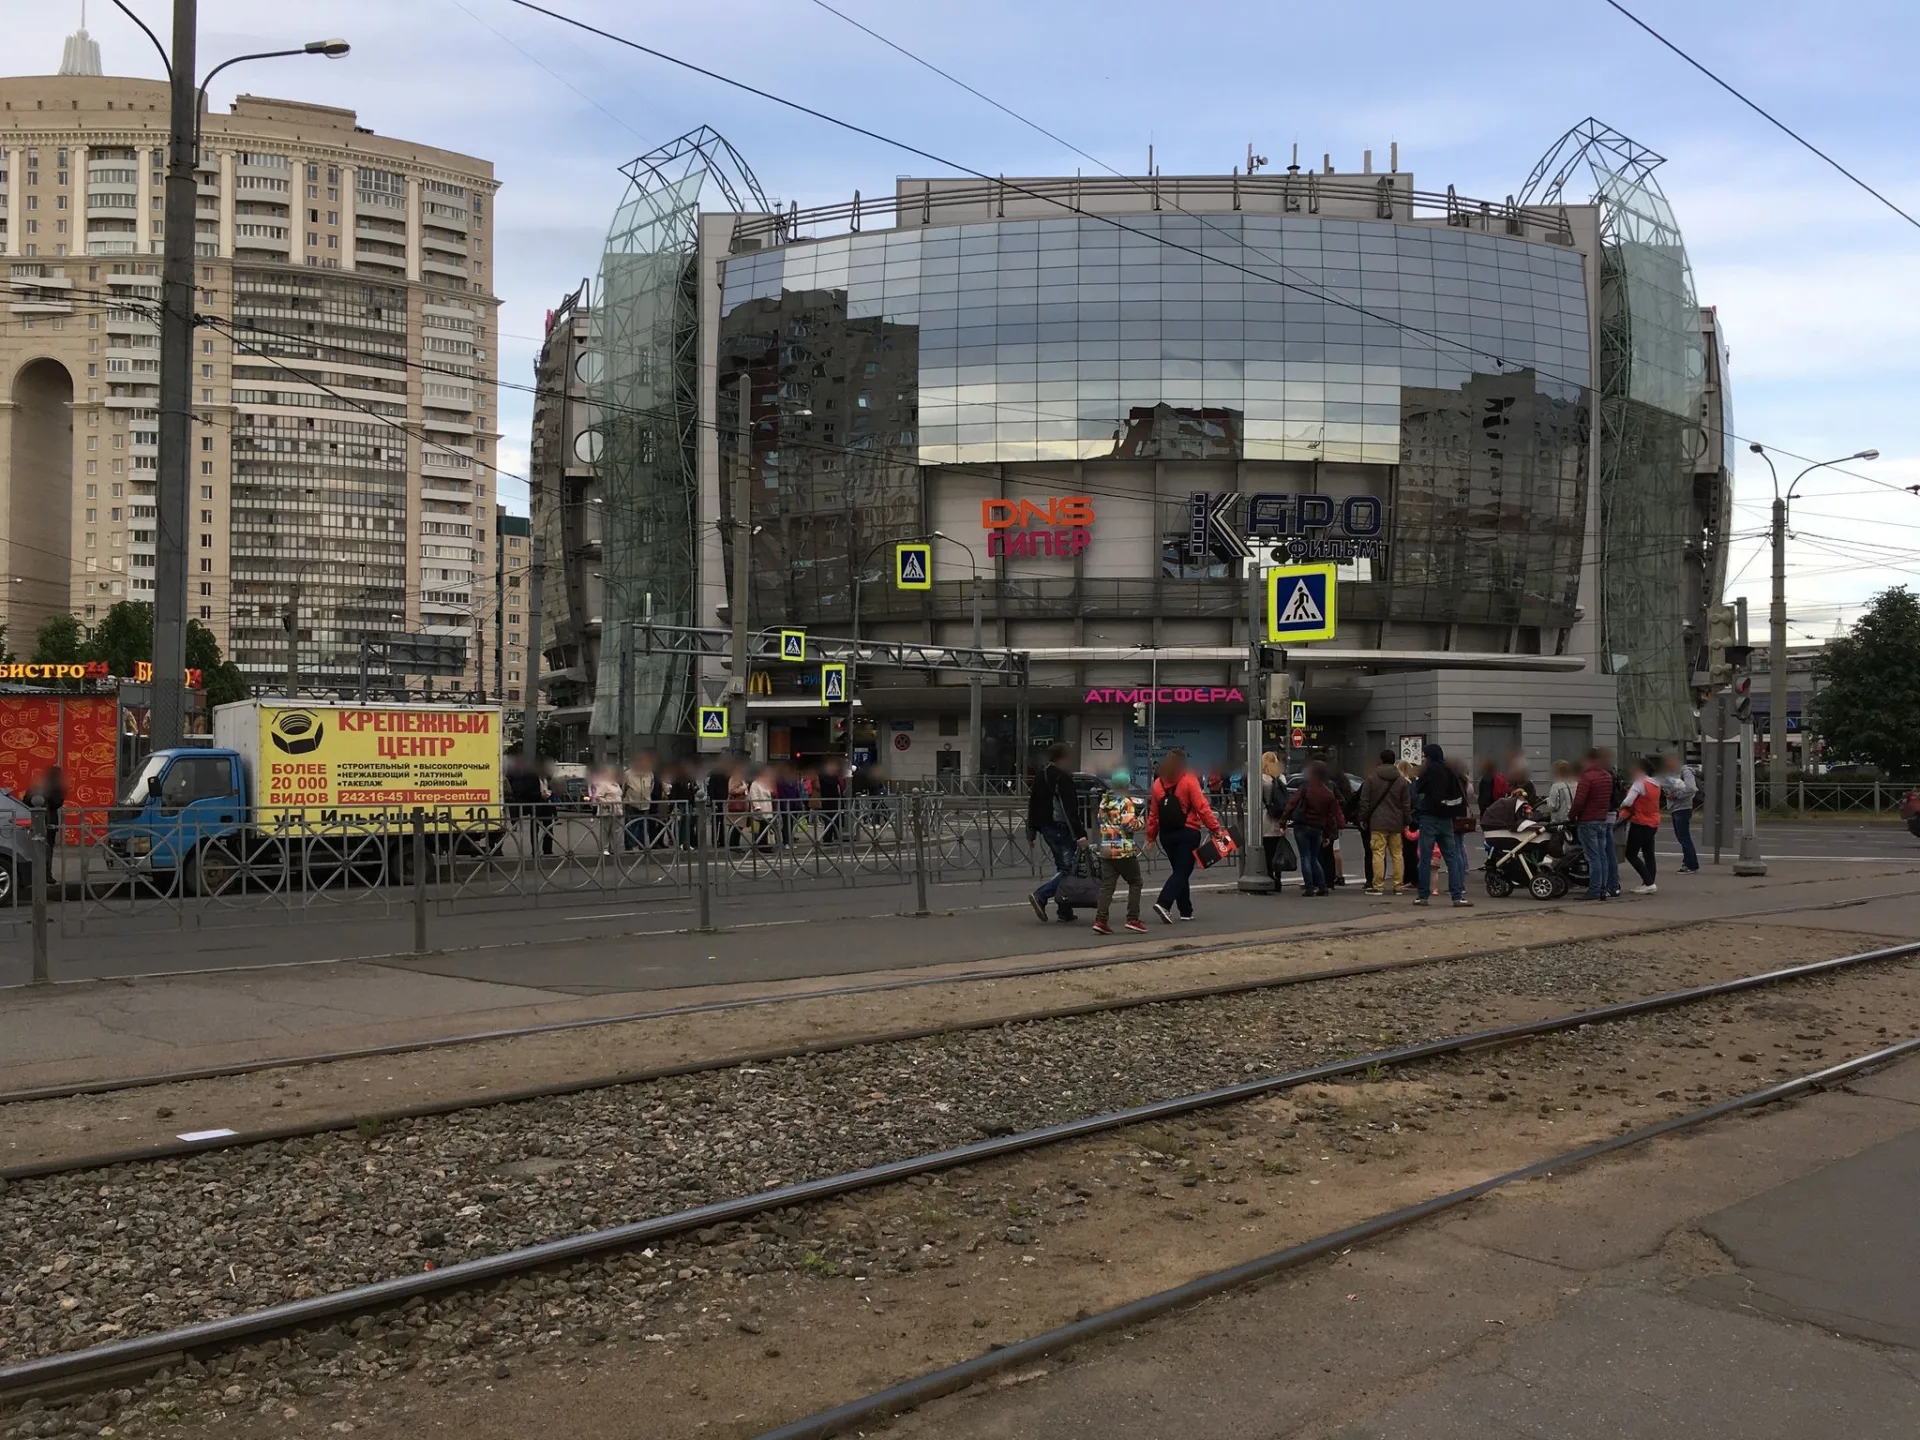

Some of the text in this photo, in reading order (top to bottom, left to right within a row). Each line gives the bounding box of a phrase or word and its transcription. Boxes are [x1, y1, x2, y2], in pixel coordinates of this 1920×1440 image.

[981, 496, 1096, 529] DNS
[987, 530, 1092, 559] ГИПЕР
[1287, 539, 1380, 560] ФИЛЬМ
[0, 664, 85, 679] БИСТРО
[1085, 688, 1244, 703] АТМОСФЕРА
[338, 711, 489, 734] КРЕПЕЖНЫЙ
[378, 736, 455, 759] ЦЕНТР
[271, 763, 327, 775] БОЛЕЕ
[342, 771, 410, 779] НЕРЖАВЕЮЩИЙ
[271, 777, 328, 790] 20 000
[419, 779, 468, 787] ДЮЙМОВЫЙ
[270, 792, 328, 805] ВИДОВ
[342, 792, 488, 803] 242-16-45 krep-centr.ru
[321, 809, 450, 826] Ильюшна
[465, 807, 489, 822] 10
